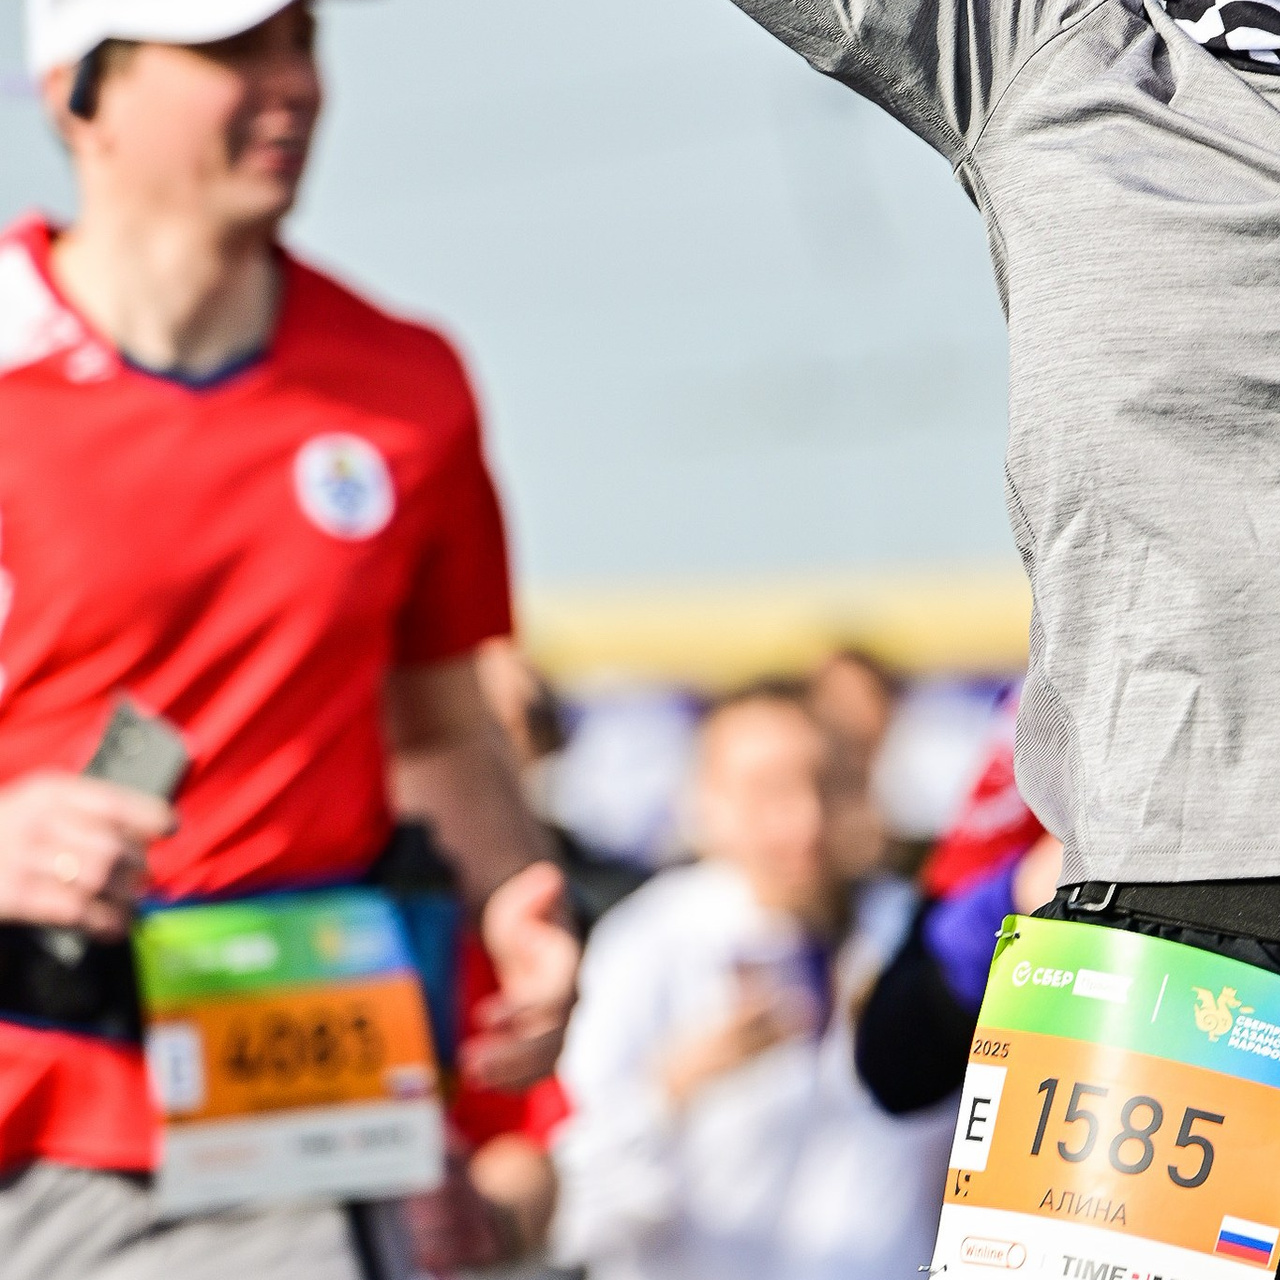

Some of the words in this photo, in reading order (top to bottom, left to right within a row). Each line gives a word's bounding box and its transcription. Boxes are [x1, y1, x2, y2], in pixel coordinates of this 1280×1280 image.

[1032, 967, 1074, 988] СБЕР
[973, 1039, 1010, 1058] 2025
[1030, 1077, 1226, 1189] 1585
[1038, 1187, 1126, 1226] АЛИНА
[965, 1243, 1004, 1261] Winline
